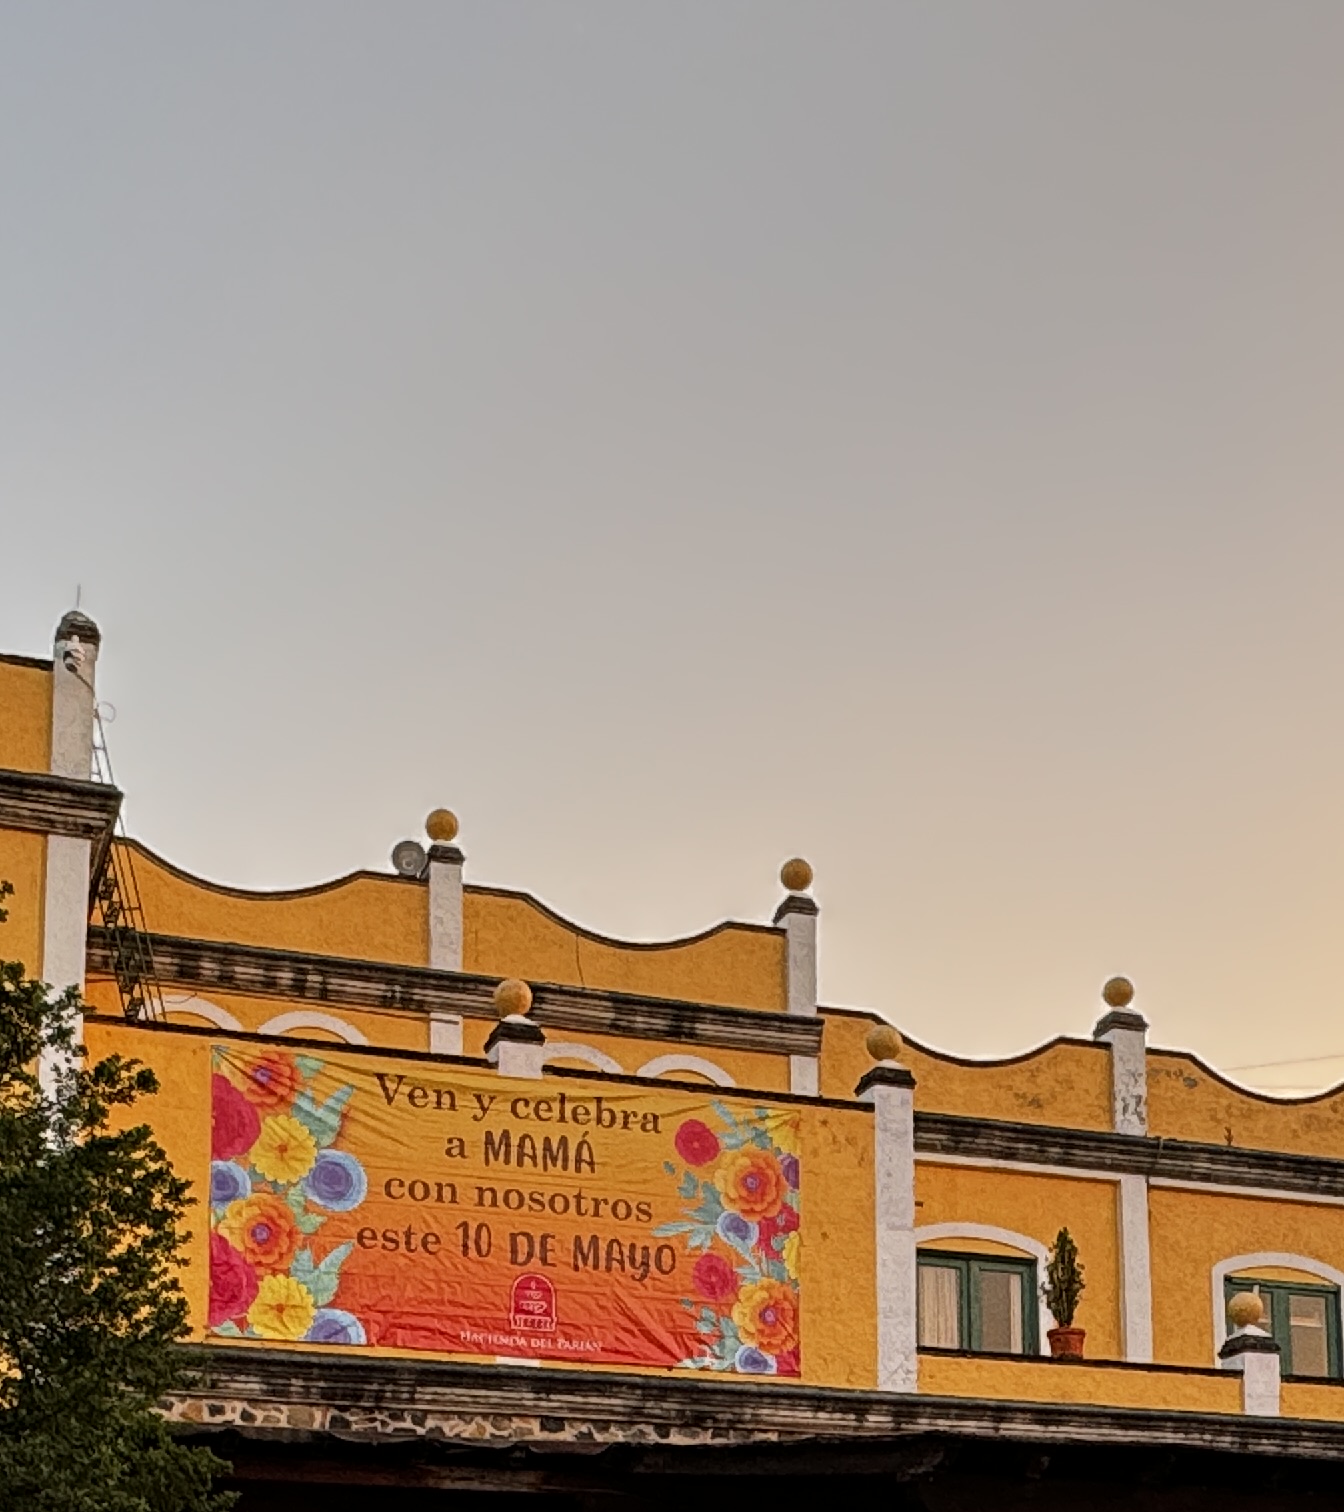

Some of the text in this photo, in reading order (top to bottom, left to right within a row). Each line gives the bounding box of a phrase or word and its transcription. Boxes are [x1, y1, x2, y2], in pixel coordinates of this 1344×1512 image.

[375, 1072, 662, 1135] Ven y celebra
[444, 1129, 596, 1174] a MAMÁ
[384, 1177, 653, 1223] con nosotros
[356, 1224, 442, 1256] este
[455, 1220, 492, 1258] 10
[509, 1230, 557, 1267] DE
